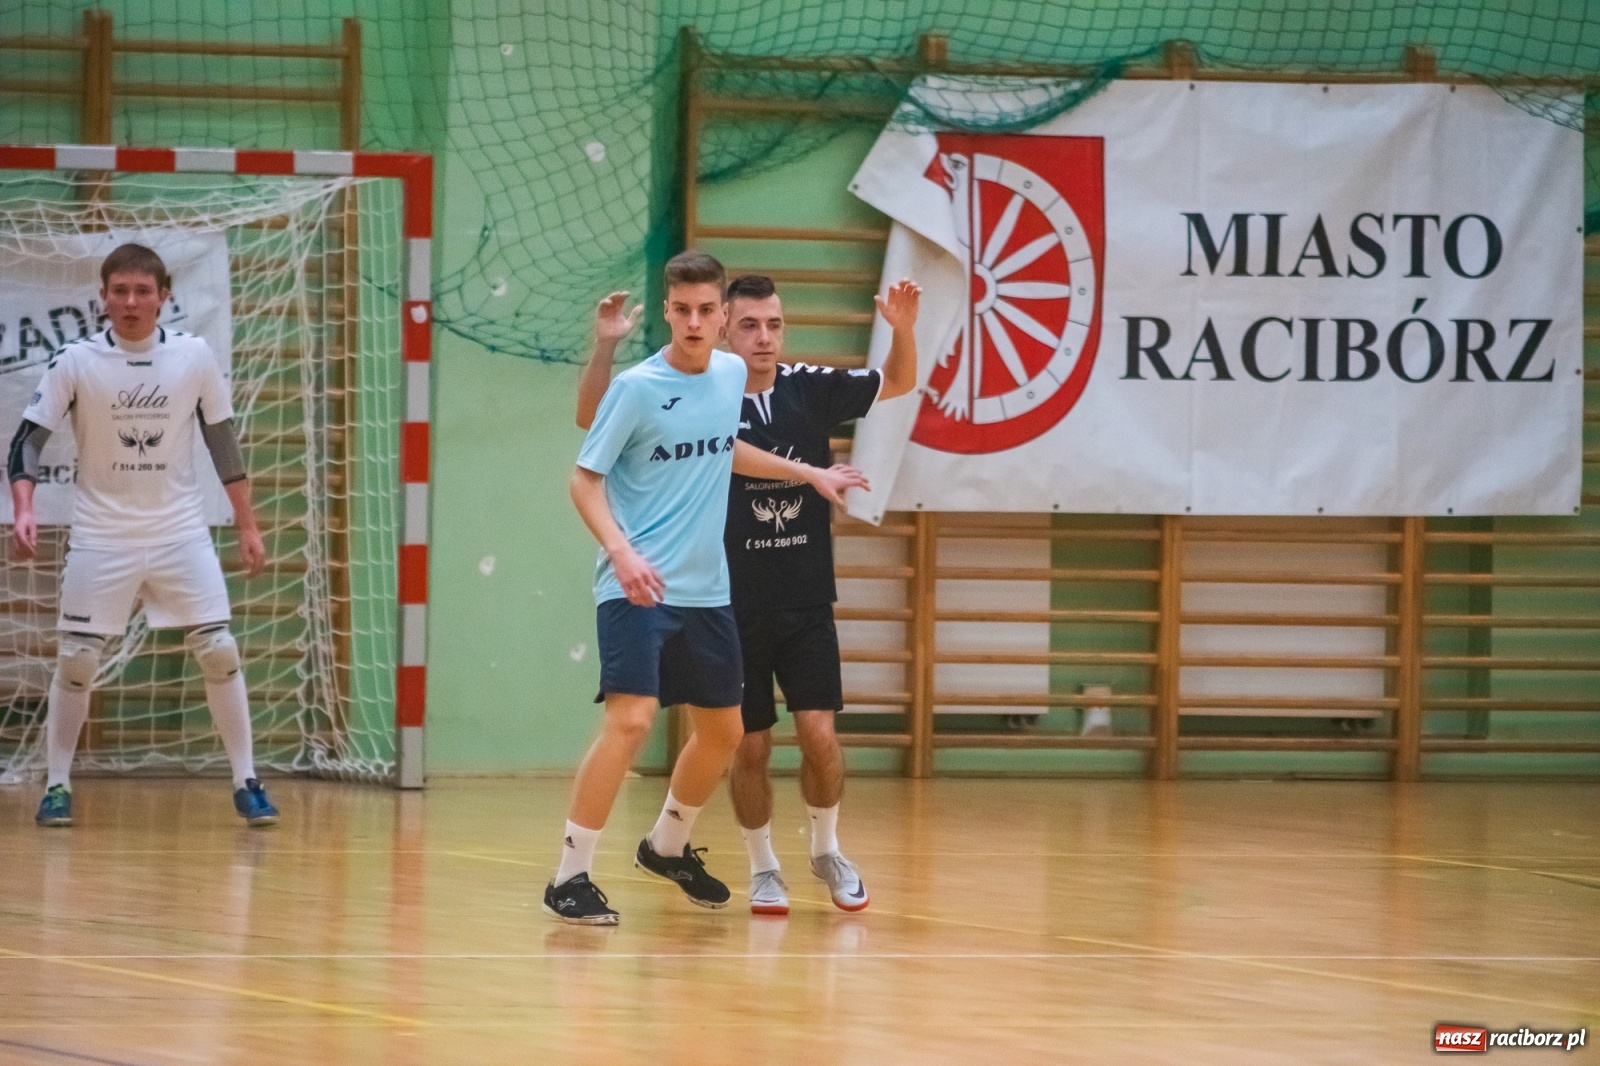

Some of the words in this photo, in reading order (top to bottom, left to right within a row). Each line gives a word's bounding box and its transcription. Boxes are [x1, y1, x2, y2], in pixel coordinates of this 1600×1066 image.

[1179, 212, 1504, 280] MIASTO
[1118, 298, 1556, 384] RACIBÓRZ
[111, 383, 169, 410] Ada
[744, 482, 770, 491] SALON
[754, 540, 772, 549] 514
[774, 537, 791, 548] 260
[791, 535, 808, 546] 902
